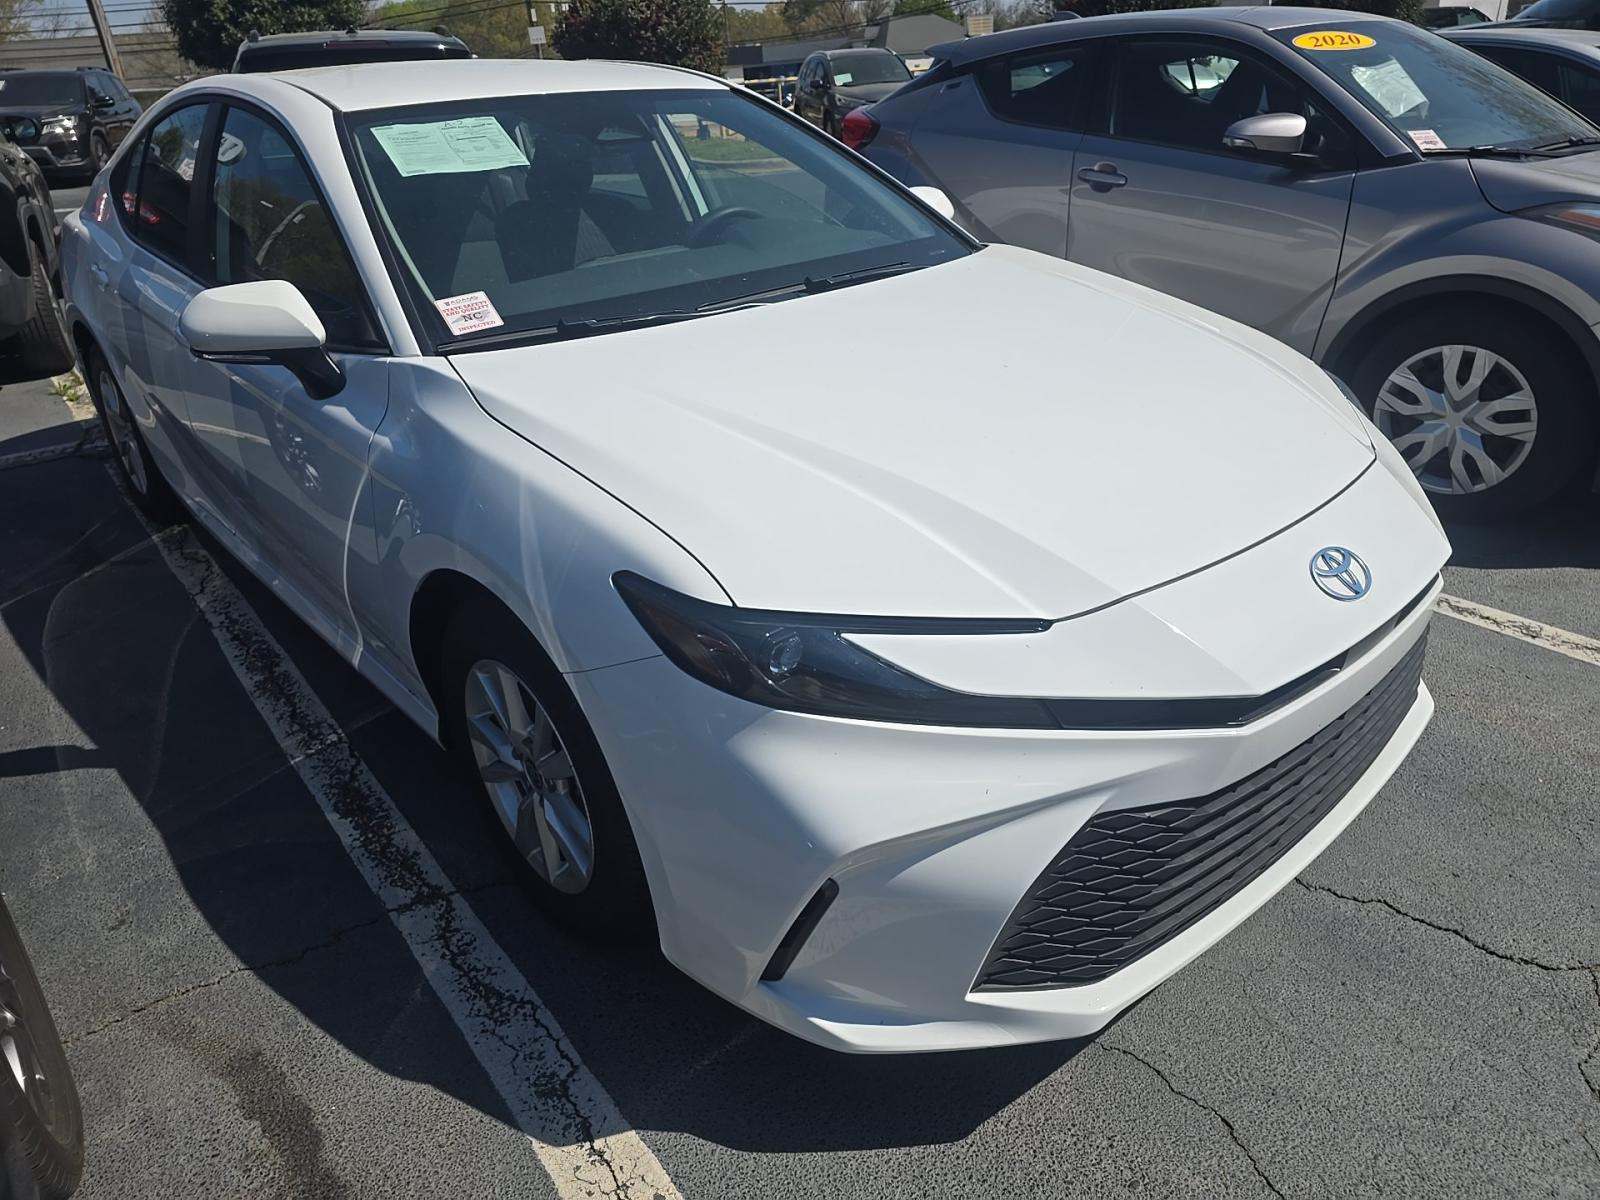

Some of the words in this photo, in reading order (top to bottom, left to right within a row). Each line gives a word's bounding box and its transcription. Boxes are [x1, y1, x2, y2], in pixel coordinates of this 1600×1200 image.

[1309, 35, 1360, 47] 2020
[442, 304, 463, 313] STATE
[463, 300, 487, 309] SAFETY
[461, 304, 489, 313] QUALITY
[462, 312, 483, 322] NC
[458, 320, 496, 332] INSPECTED
